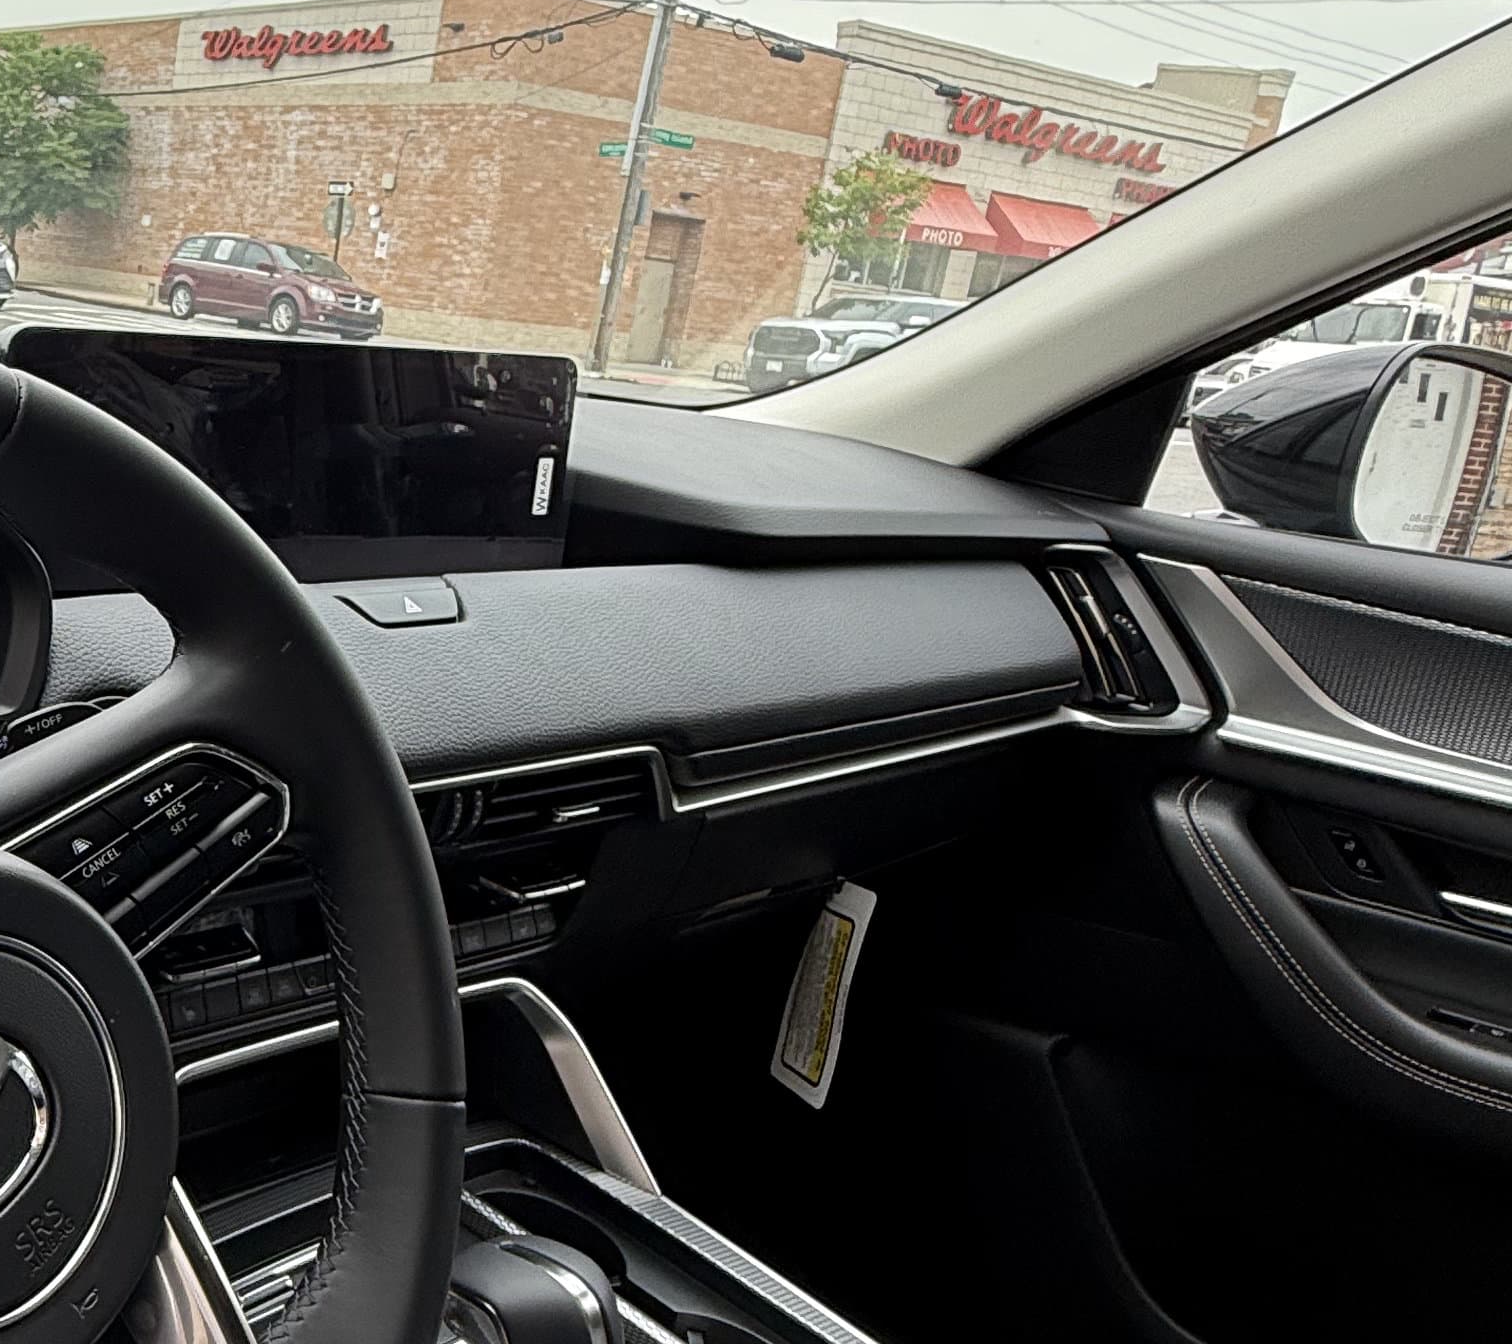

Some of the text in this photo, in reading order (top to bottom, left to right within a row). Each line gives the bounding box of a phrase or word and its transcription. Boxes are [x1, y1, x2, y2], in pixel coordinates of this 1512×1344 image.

[202, 24, 393, 70] Walgreens
[886, 132, 961, 167] PHOTO
[948, 94, 1166, 173] Walgreens
[921, 227, 964, 247] PHOTO
[165, 800, 186, 819] RES
[82, 847, 121, 878] CANCEL
[15, 1199, 64, 1261] SRS
